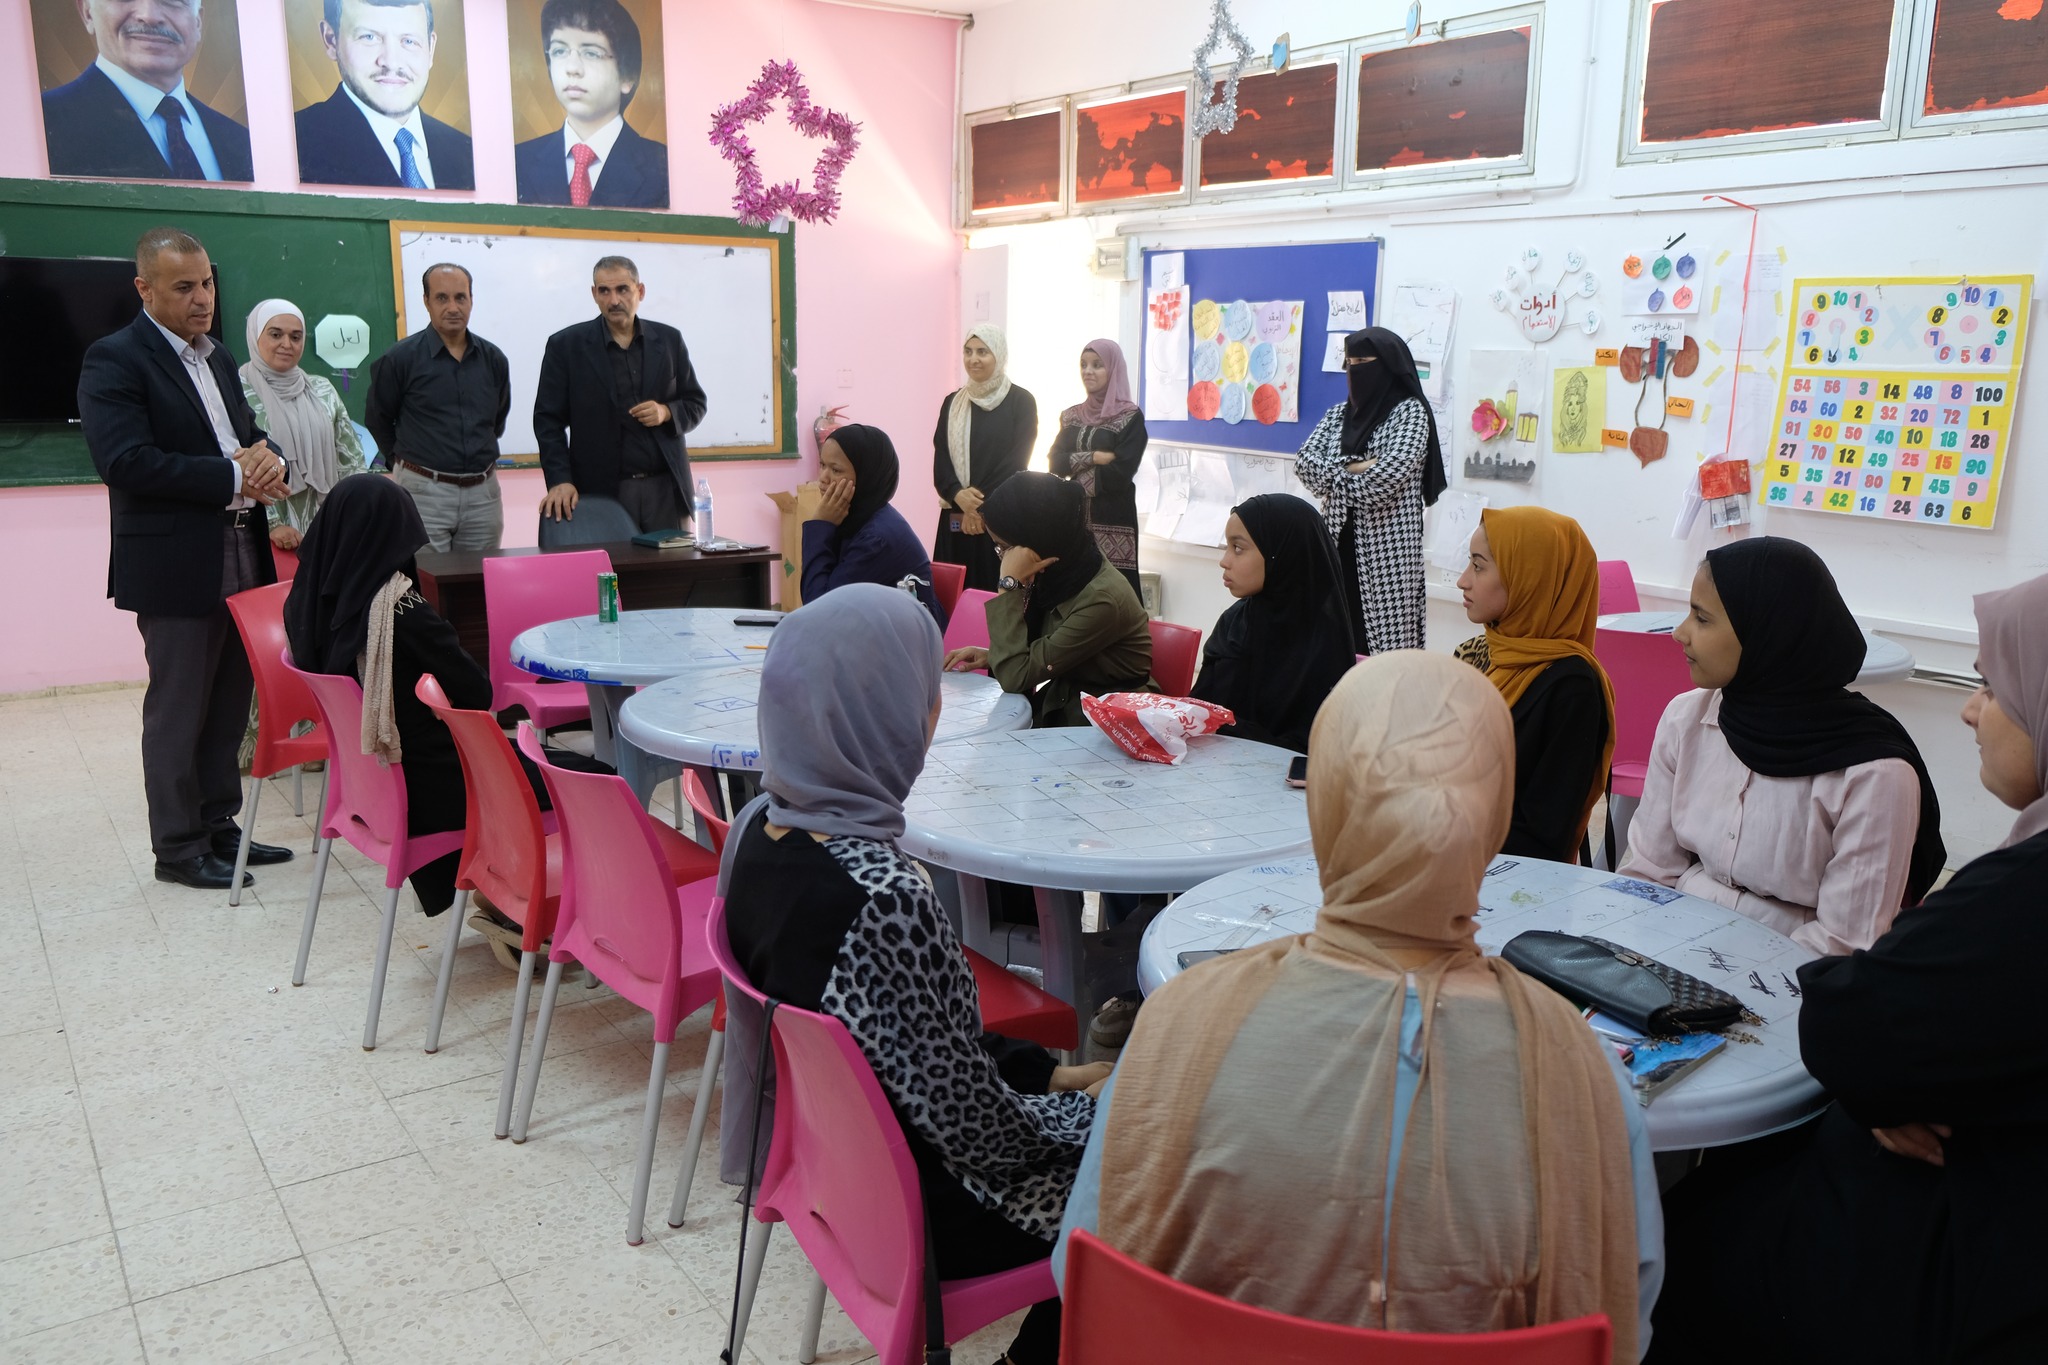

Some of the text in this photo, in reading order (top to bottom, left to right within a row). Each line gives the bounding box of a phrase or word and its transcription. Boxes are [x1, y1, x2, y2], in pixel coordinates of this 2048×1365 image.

[1817, 295, 1827, 307] 9
[1834, 291, 1847, 305] 10
[1854, 294, 1861, 308] 1
[1947, 293, 1956, 307] 9
[1964, 287, 1980, 303] 10
[1989, 292, 1997, 306] 1
[1806, 313, 1814, 325] 8
[1865, 309, 1873, 322] 2
[1932, 309, 1944, 323] 8
[1997, 310, 2008, 323] 2
[333, 328, 360, 350] لعل
[1802, 332, 1810, 346] 7
[1860, 330, 1868, 345] 3
[1930, 331, 1940, 345] 7
[1995, 330, 2006, 345] 3
[1809, 349, 1818, 360] 6
[1849, 347, 1858, 360] 4
[1940, 347, 1949, 359] 6
[1961, 350, 1970, 363] 5
[1981, 347, 1990, 362] 4
[1794, 379, 2003, 402] 54 56 3 14 48 8 100
[1790, 400, 1990, 425] 64 60 2 32 20 72 1
[1785, 421, 1989, 449] 81 30 50 40 10 18 28
[1780, 443, 1986, 474] 27 70 12 49 25 15 90
[1780, 464, 1978, 496] 5 35 21 80 7 45 9
[1770, 487, 1971, 520] 36 4 42 16 24 63 6
